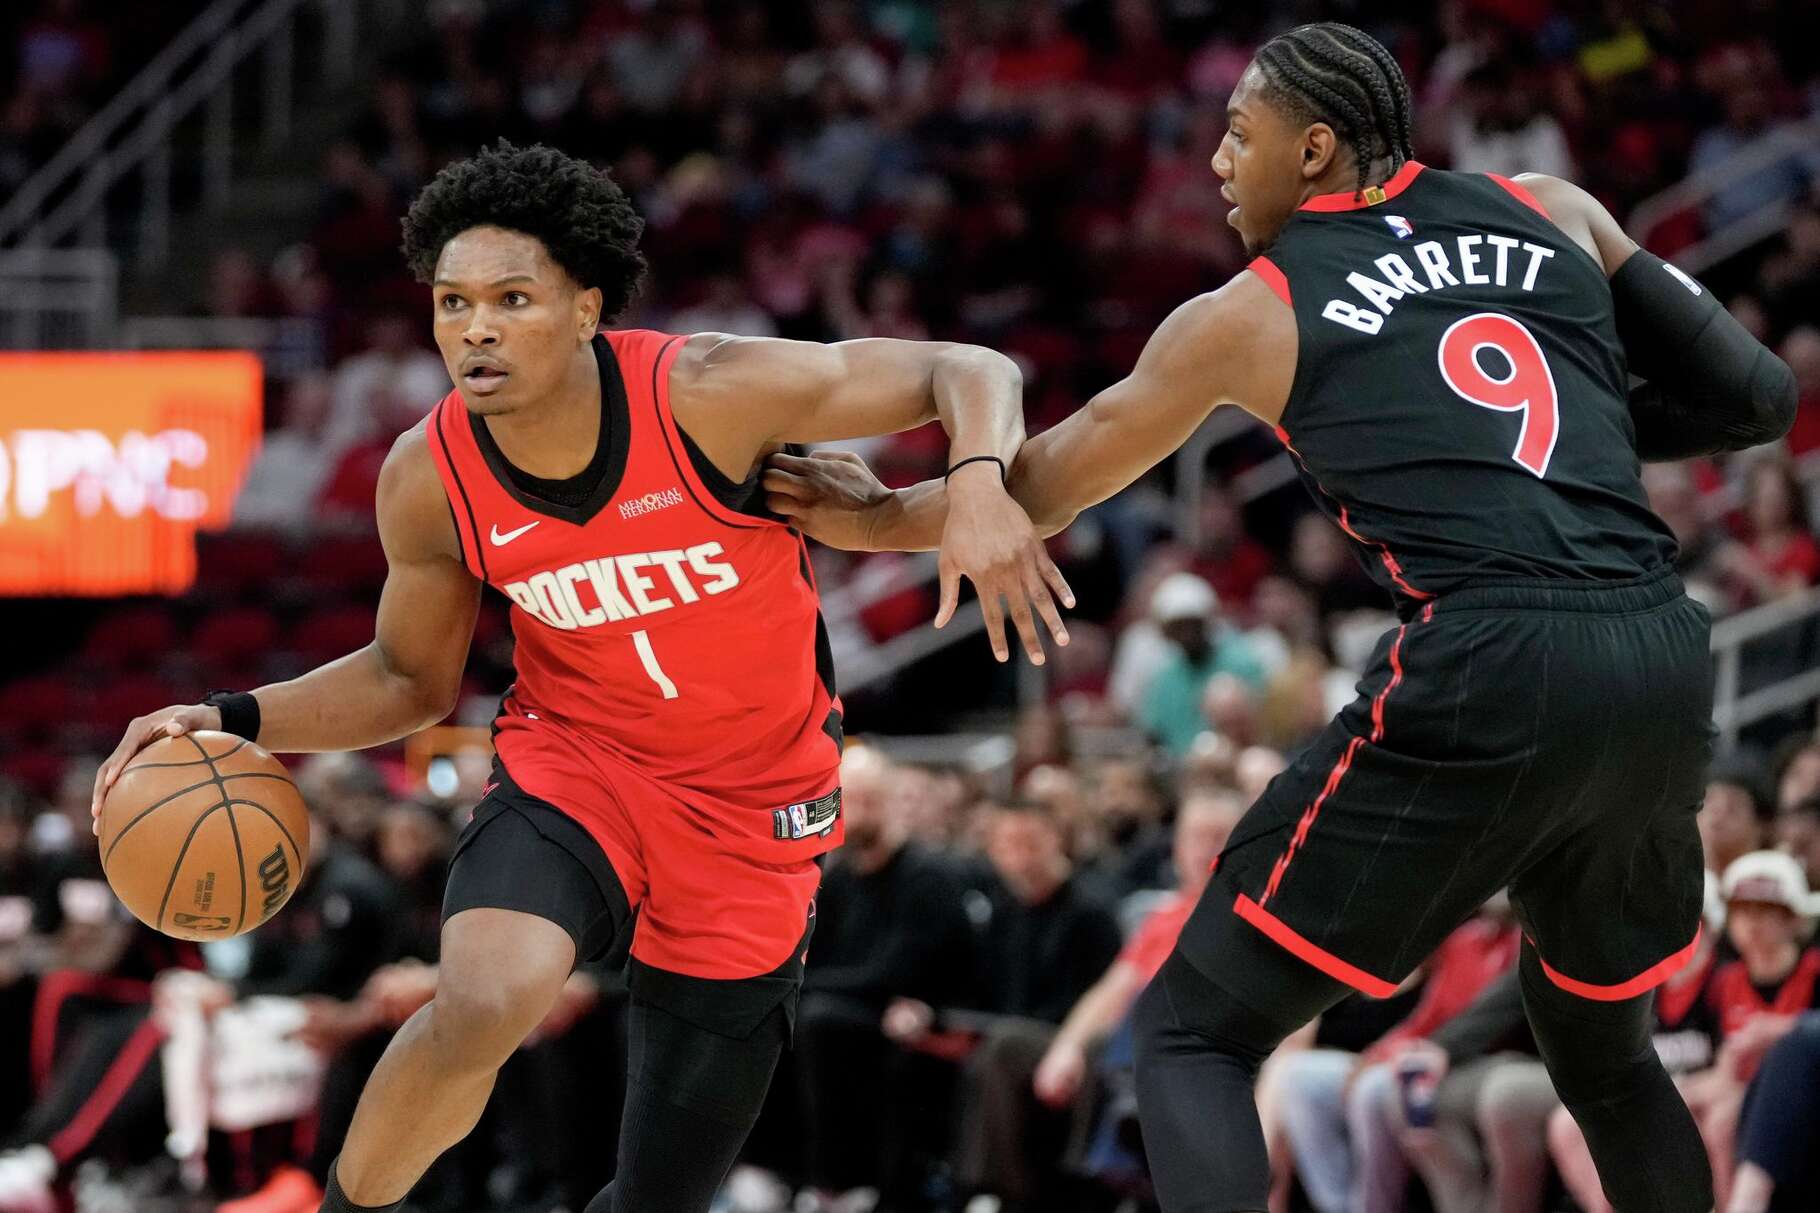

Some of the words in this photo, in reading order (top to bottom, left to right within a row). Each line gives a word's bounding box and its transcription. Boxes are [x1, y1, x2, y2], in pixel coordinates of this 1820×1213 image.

[1321, 234, 1555, 336] BARRETT
[1437, 312, 1560, 480] 9
[12, 429, 209, 520] PNC
[618, 488, 681, 512] MEMORIAL
[621, 493, 684, 519] HERMANN
[504, 541, 740, 630] ROCKETS
[624, 629, 679, 700] 1
